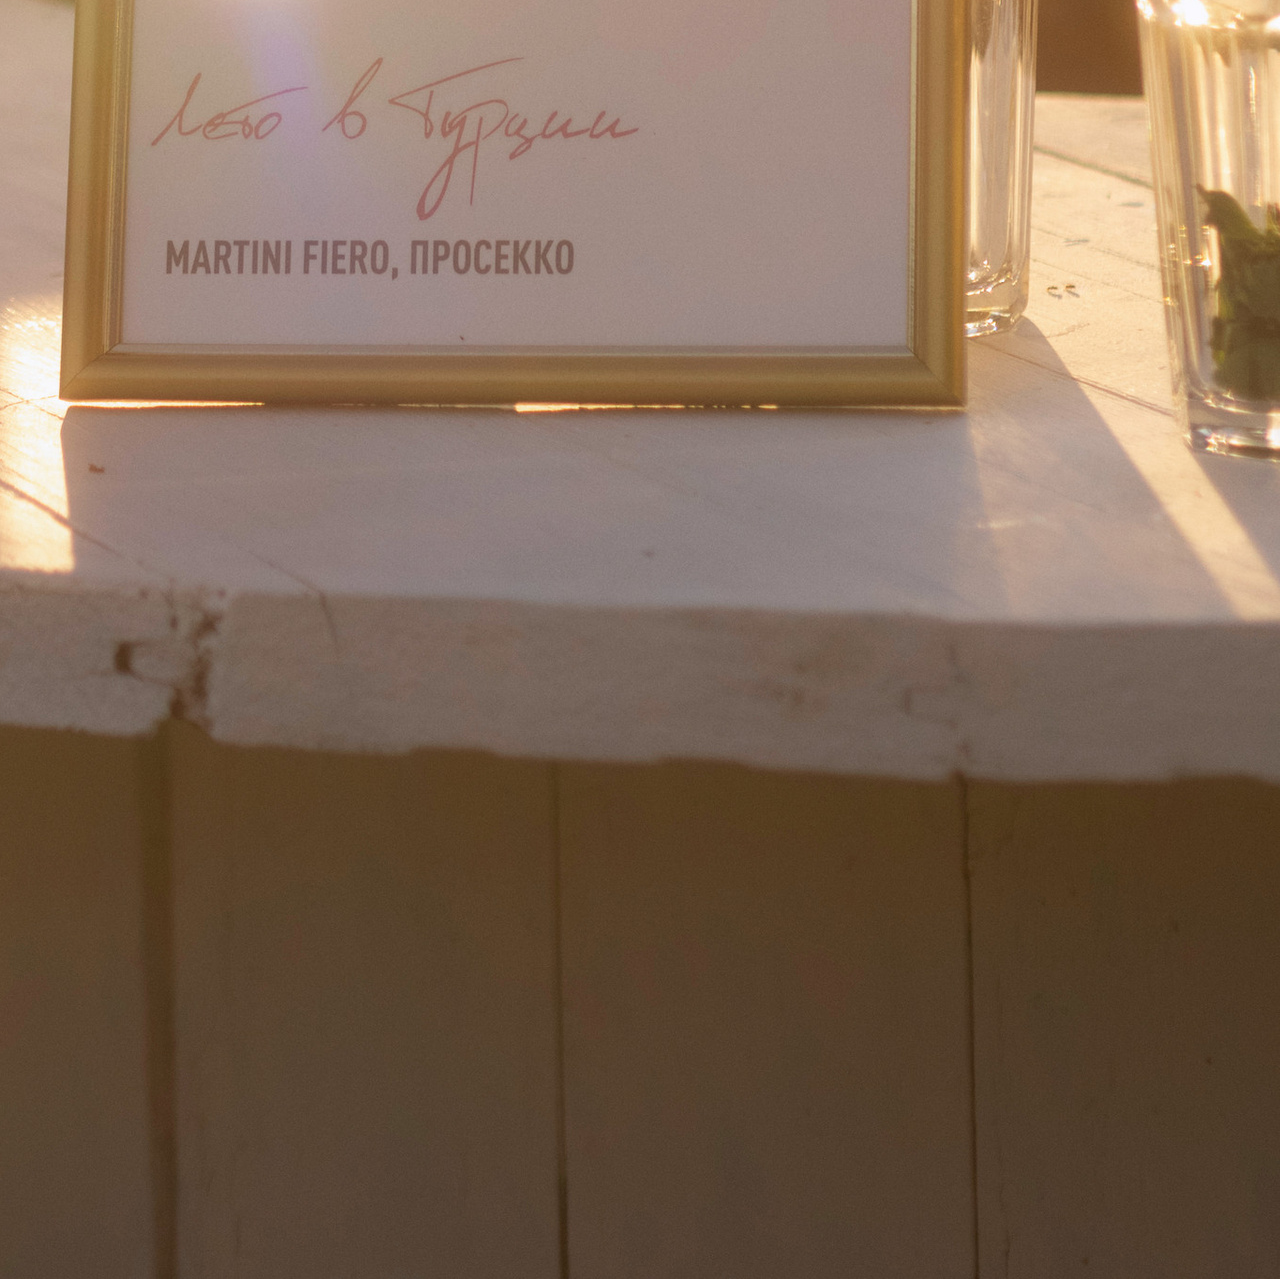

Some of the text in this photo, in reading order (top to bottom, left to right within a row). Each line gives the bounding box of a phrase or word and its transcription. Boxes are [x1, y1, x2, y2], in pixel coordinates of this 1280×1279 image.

[152, 57, 639, 221] Лето в Турции
[166, 239, 574, 279] MARTINI FIERO, ПРОСЕККО
